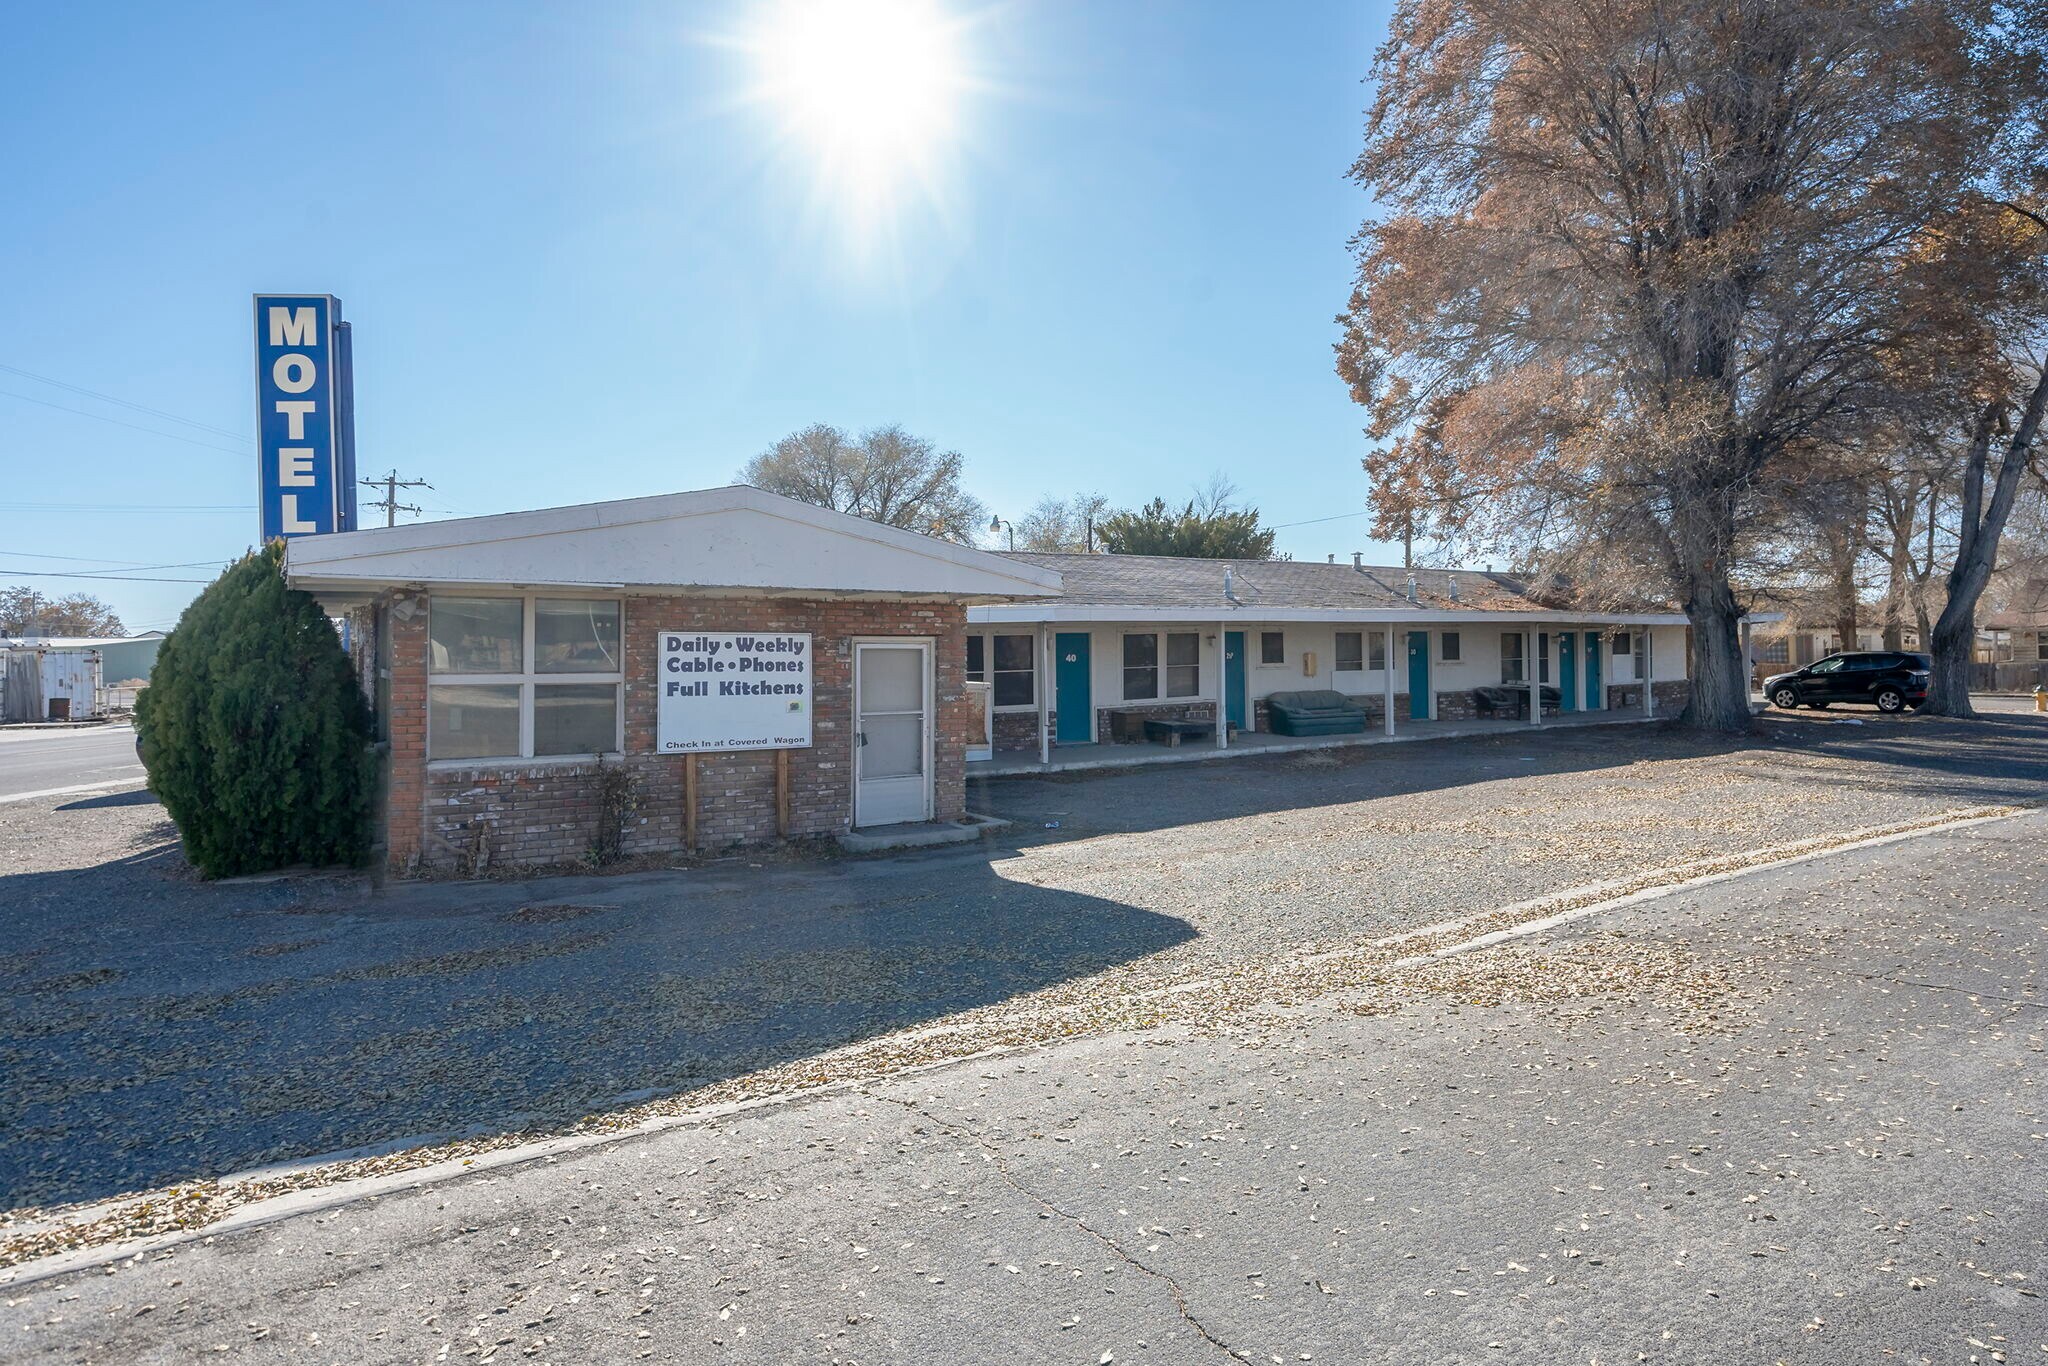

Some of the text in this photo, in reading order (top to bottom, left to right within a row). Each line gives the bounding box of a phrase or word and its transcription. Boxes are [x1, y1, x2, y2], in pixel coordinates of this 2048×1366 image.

[268, 306, 317, 534] MOTEL
[666, 636, 805, 656] Daily Weekly
[666, 657, 804, 673] Cable Phones
[1065, 654, 1077, 662] 40
[666, 680, 804, 697] Full Kitchens
[666, 741, 699, 749] Check
[701, 740, 711, 748] In
[728, 738, 768, 746] Covered
[773, 737, 805, 745] Wagon
